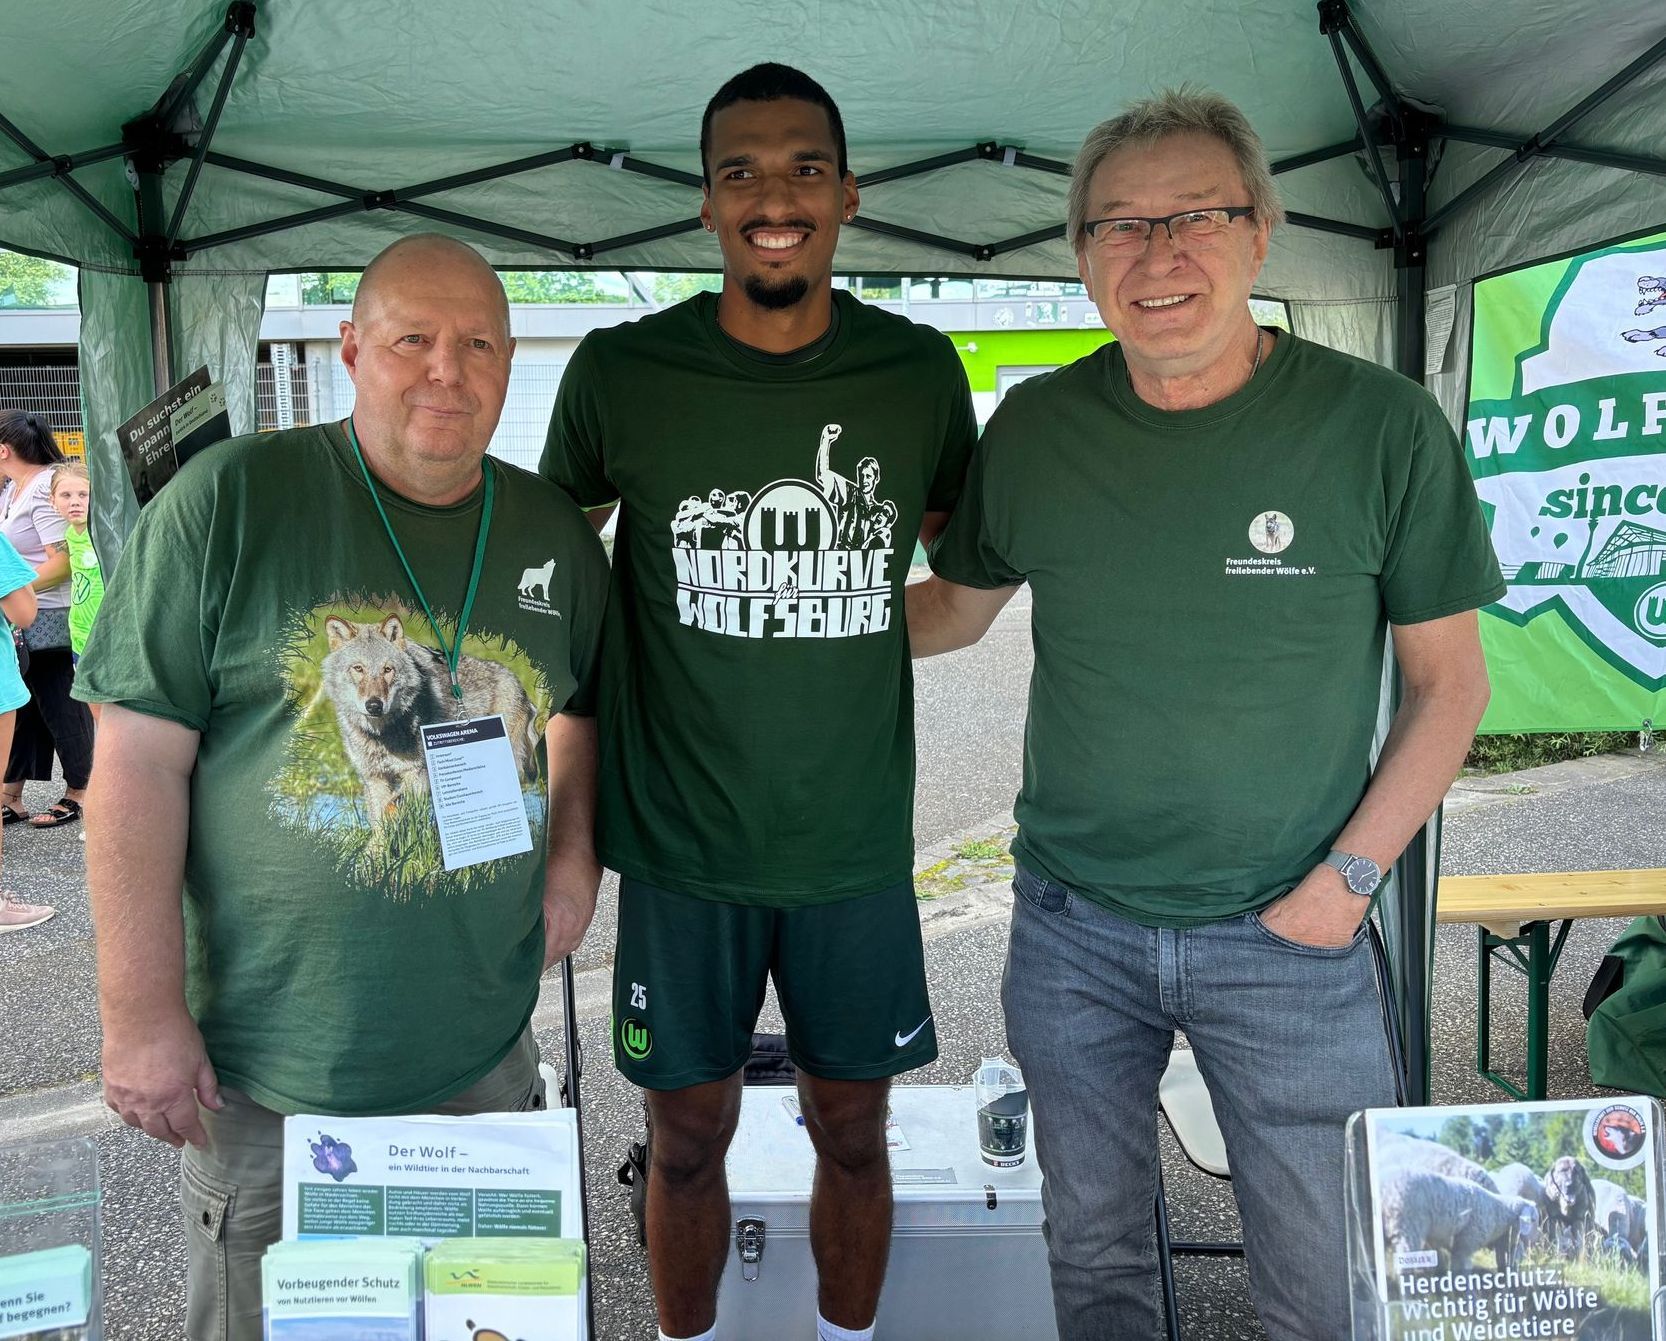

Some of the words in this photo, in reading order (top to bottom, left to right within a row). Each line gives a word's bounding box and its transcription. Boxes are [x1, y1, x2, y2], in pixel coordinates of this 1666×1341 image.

[129, 425, 145, 443] Du
[147, 397, 182, 429] suchst
[184, 384, 201, 402] ein
[672, 548, 894, 592] NORDKURVE
[1225, 566, 1275, 575] freilebender
[1275, 566, 1300, 575] Wölfe
[1301, 566, 1316, 575] e.V.
[1226, 557, 1282, 565] Freundeskreis
[773, 582, 799, 606] für
[676, 590, 891, 638] WOLFSBURG
[426, 730, 460, 741] VOLKSWAGEN
[460, 728, 479, 736] ARENA
[630, 982, 647, 1010] 25
[388, 1144, 416, 1157] Der
[419, 1146, 456, 1159] Wolf
[388, 1163, 402, 1172] ein
[404, 1164, 439, 1173] Wildtier
[441, 1164, 449, 1173] in
[451, 1165, 466, 1173] der
[468, 1166, 530, 1175] Nachbarschaft
[277, 1277, 360, 1290] Vorbeugender
[362, 1276, 400, 1288] Schutz
[1400, 1266, 1563, 1296] Herdenschutz:
[25, 1291, 45, 1304] Sie
[277, 1298, 291, 1306] von
[293, 1296, 334, 1305] Nutztieren
[349, 1295, 377, 1304] Wölfen
[1402, 1296, 1489, 1321] wichtig
[1494, 1293, 1528, 1314] für
[1533, 1288, 1599, 1312] Wölfe
[7, 1301, 71, 1322] begegnen?
[1404, 1322, 1446, 1341] und
[1452, 1316, 1575, 1341] Weidetiere
